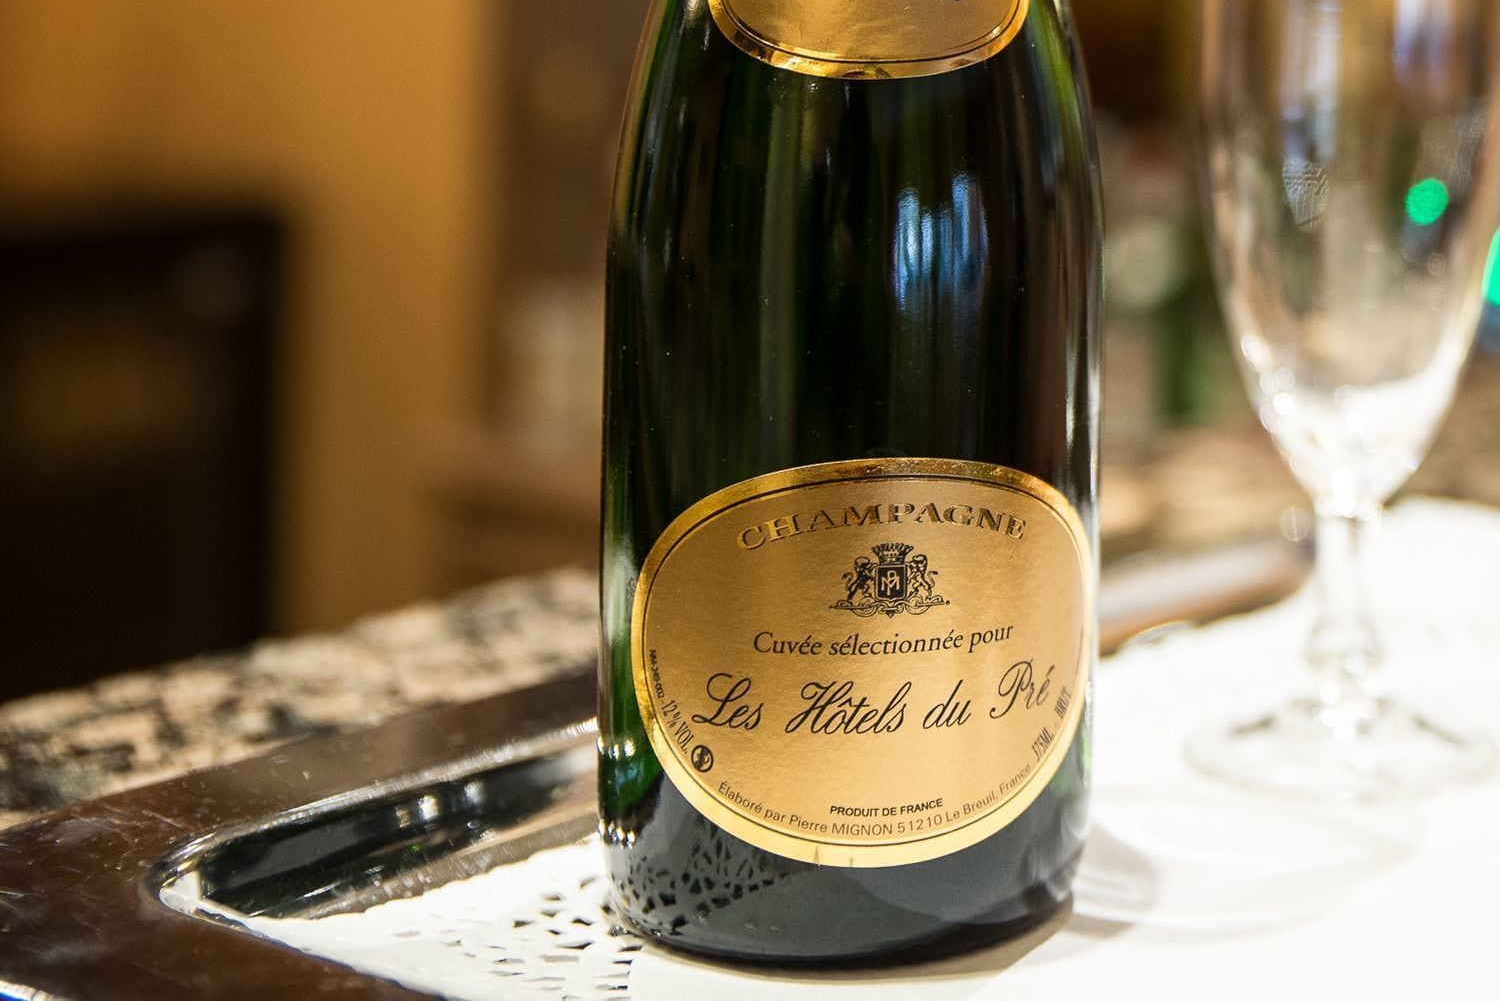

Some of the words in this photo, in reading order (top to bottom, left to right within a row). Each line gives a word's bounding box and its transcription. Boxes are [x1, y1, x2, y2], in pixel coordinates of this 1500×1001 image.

[735, 502, 1027, 551] CHAMPAGNE
[752, 631, 822, 656] Cuvée
[828, 628, 964, 656] sélectionnée
[967, 625, 1014, 654] pour
[691, 672, 764, 731] Les
[785, 681, 912, 735] Hôtels
[922, 679, 972, 730] du
[989, 658, 1056, 720] Pré
[717, 780, 763, 814] Élaboré
[763, 808, 787, 823] par
[789, 814, 828, 834] Pierre
[831, 822, 893, 836] MIGNON
[896, 814, 943, 835] 51210
[945, 810, 961, 823] Le
[998, 764, 1032, 796] France
[829, 805, 880, 818] PRODUIT
[881, 807, 898, 817] DE
[899, 797, 944, 816] FRANCE
